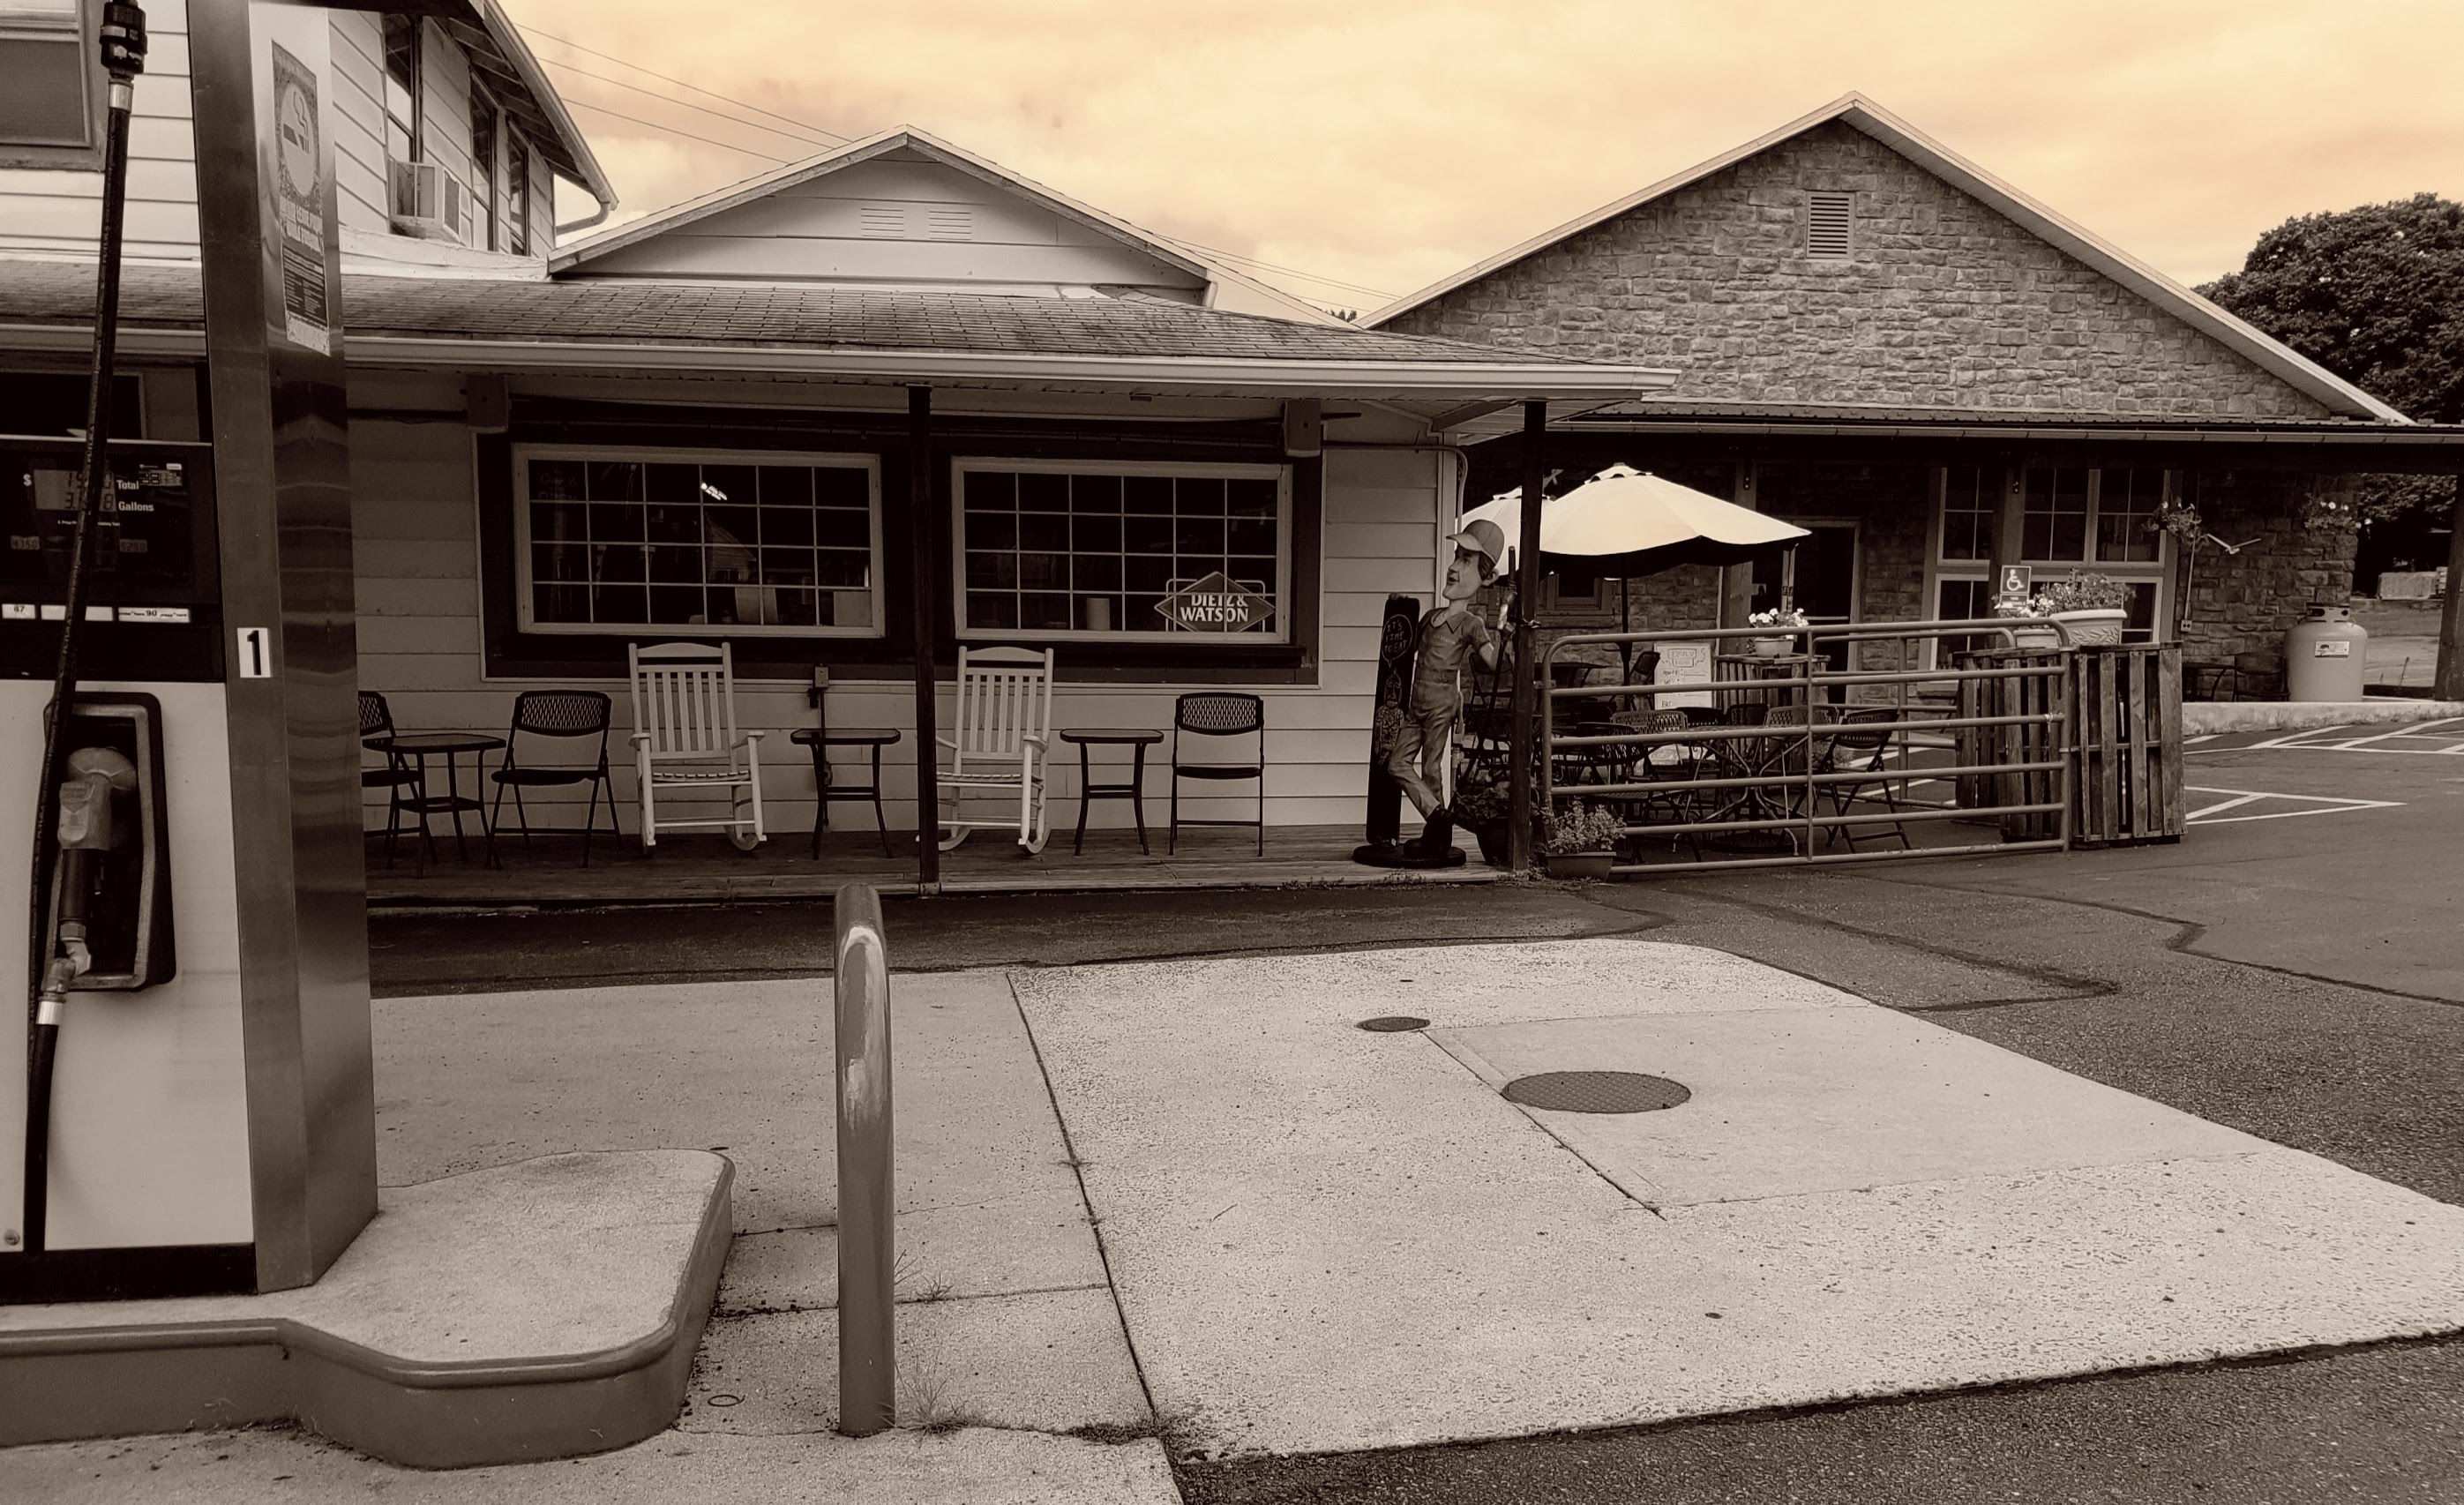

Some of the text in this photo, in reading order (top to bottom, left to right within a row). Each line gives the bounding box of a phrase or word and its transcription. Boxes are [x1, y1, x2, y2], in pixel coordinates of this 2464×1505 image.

[116, 480, 139, 490] Total
[118, 500, 154, 512] Gallons
[1236, 594, 1249, 607] &
[1180, 607, 1249, 622] WATSON
[1387, 618, 1403, 633] IT'S
[247, 630, 262, 676] 1
[1384, 640, 1408, 653] TO EAT
